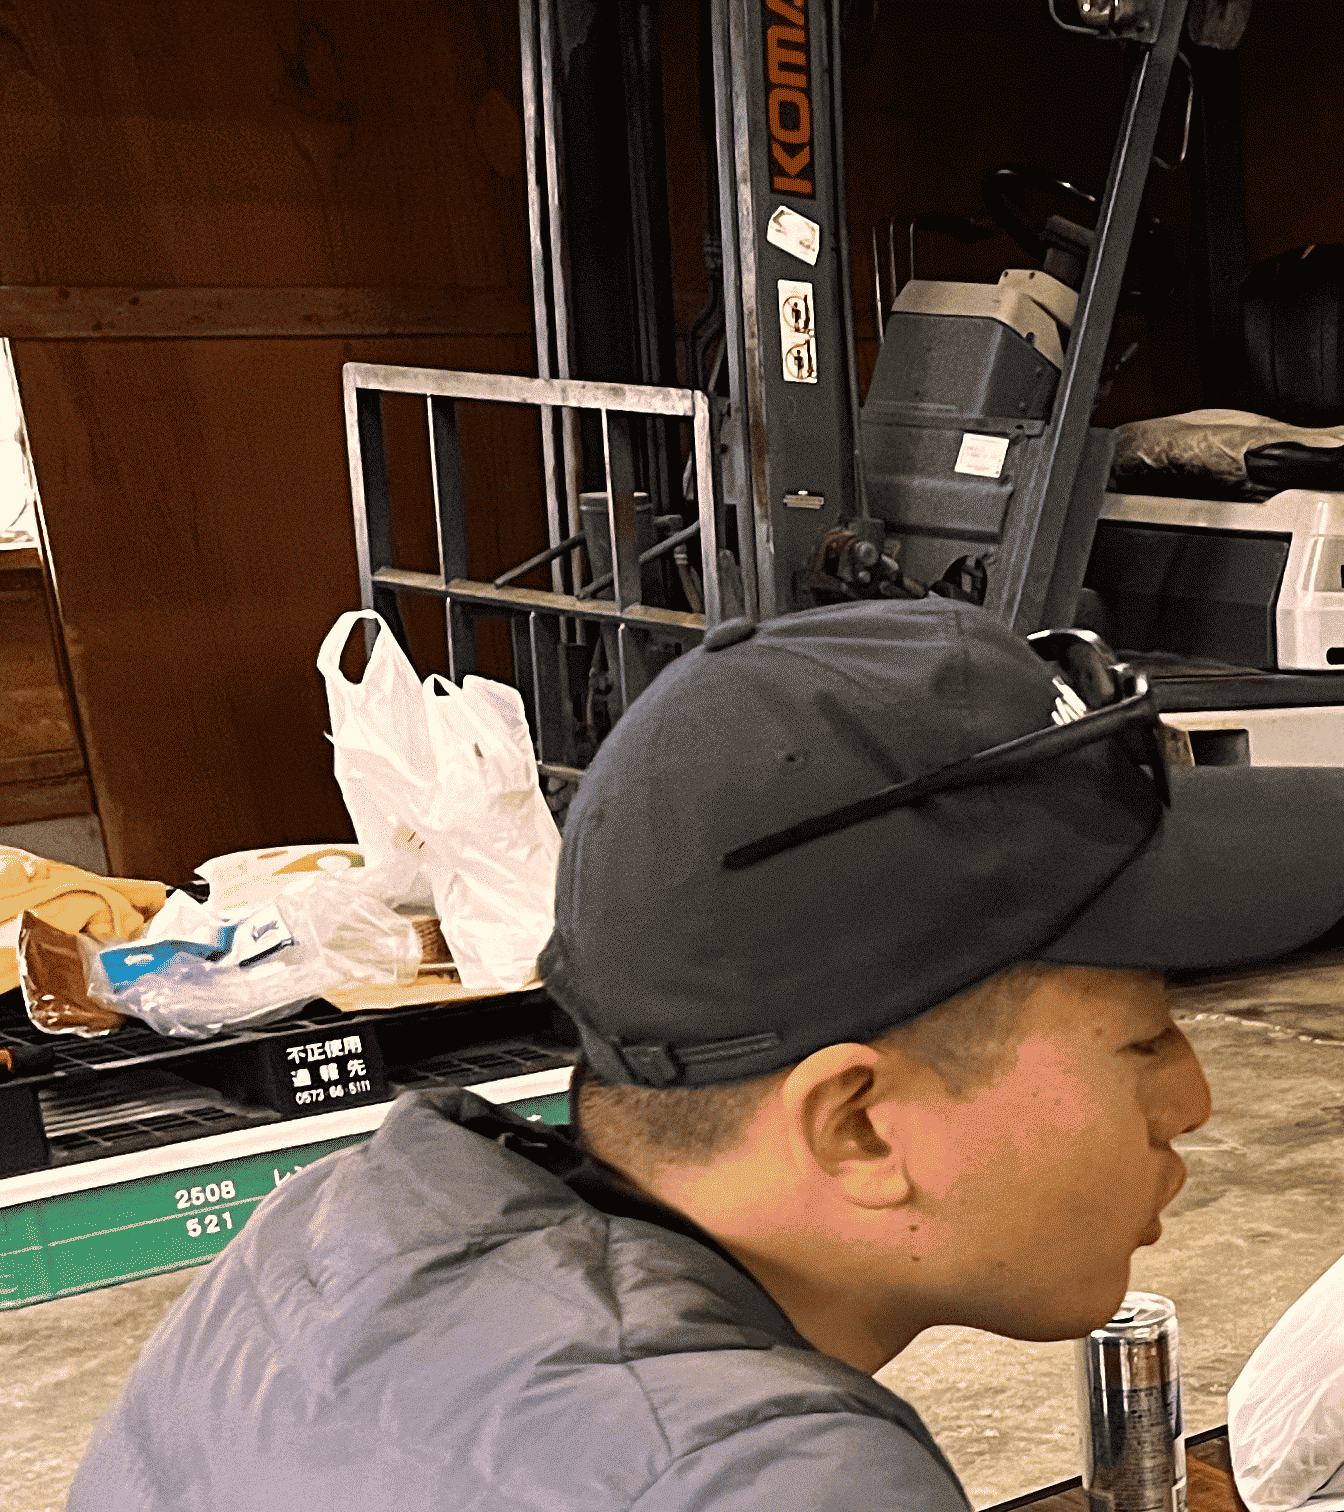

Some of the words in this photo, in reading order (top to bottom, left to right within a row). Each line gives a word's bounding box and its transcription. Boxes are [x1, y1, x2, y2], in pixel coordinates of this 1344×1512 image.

[286, 1035, 362, 1064] 不正使用
[185, 1210, 233, 1238] 521
